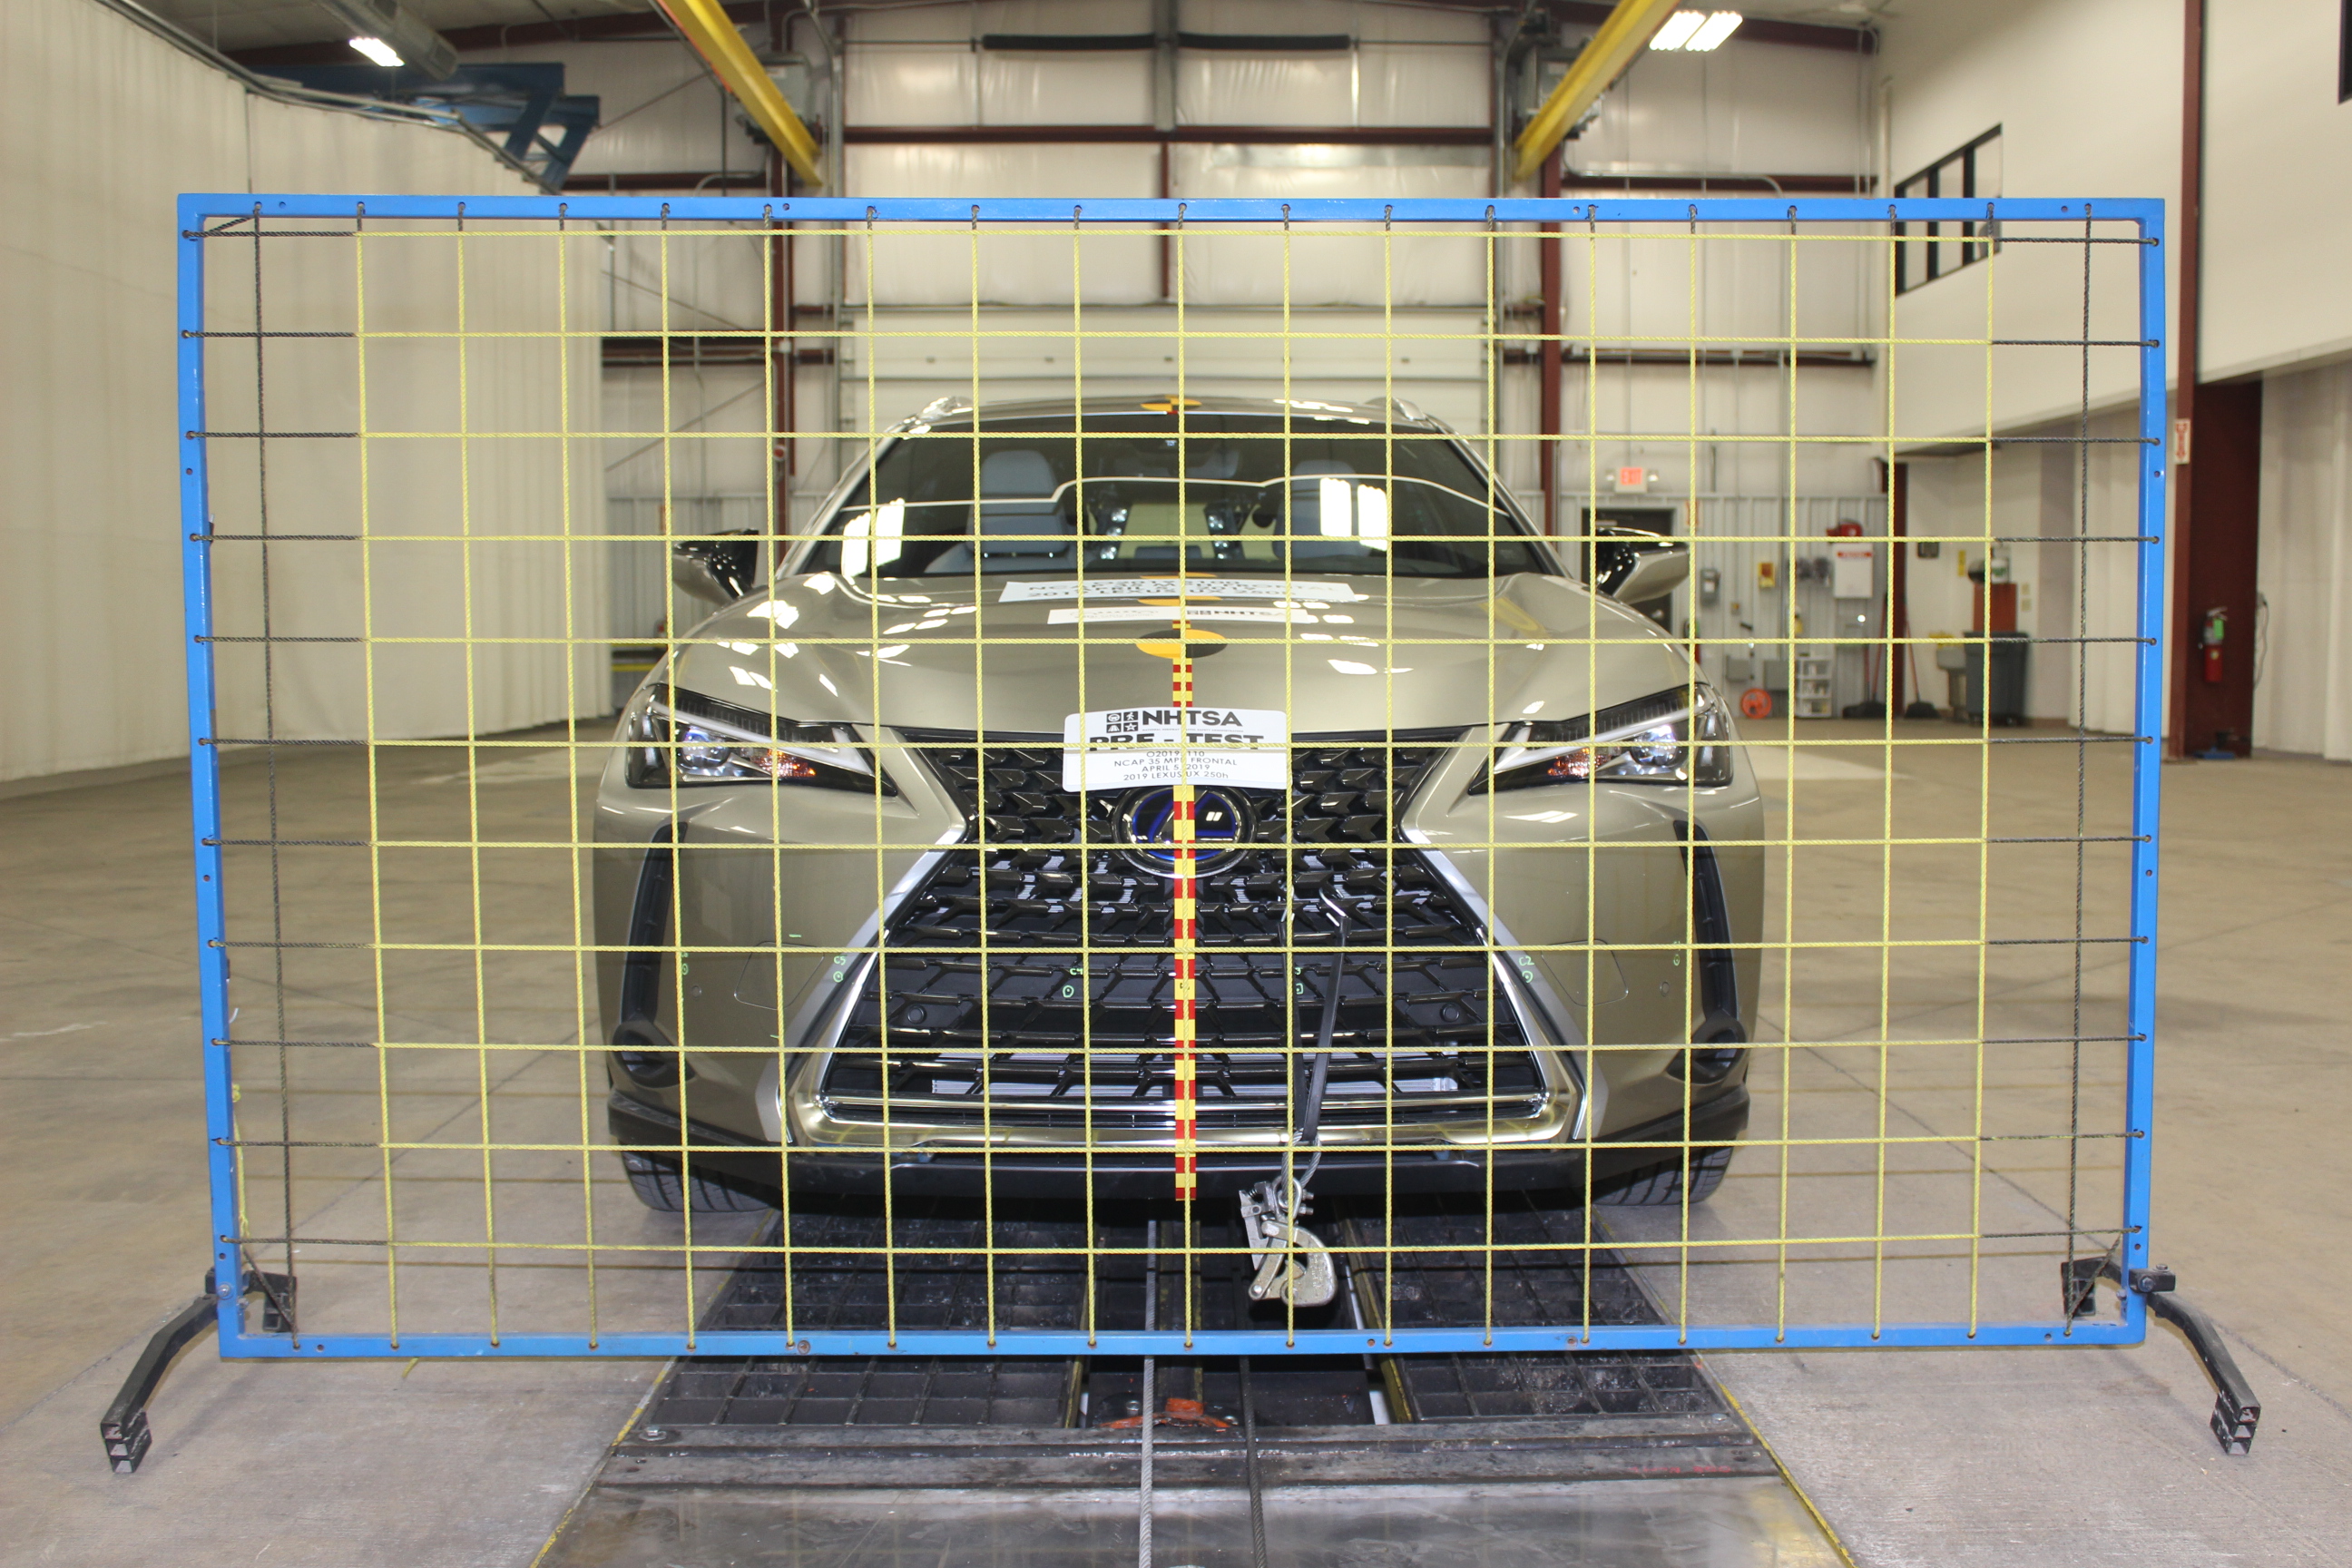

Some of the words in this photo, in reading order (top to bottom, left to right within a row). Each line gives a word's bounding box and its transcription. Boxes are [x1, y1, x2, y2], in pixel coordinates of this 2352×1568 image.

[1142, 710, 1242, 727] NHTSA
[1113, 759, 1144, 768] NCAP
[1191, 757, 1238, 766] FRONTAL
[1123, 773, 1148, 781] 2019
[1152, 771, 1182, 779] LEXUS
[1203, 770, 1229, 779] 250h
[833, 955, 847, 966] C5
[1518, 956, 1534, 966] C2
